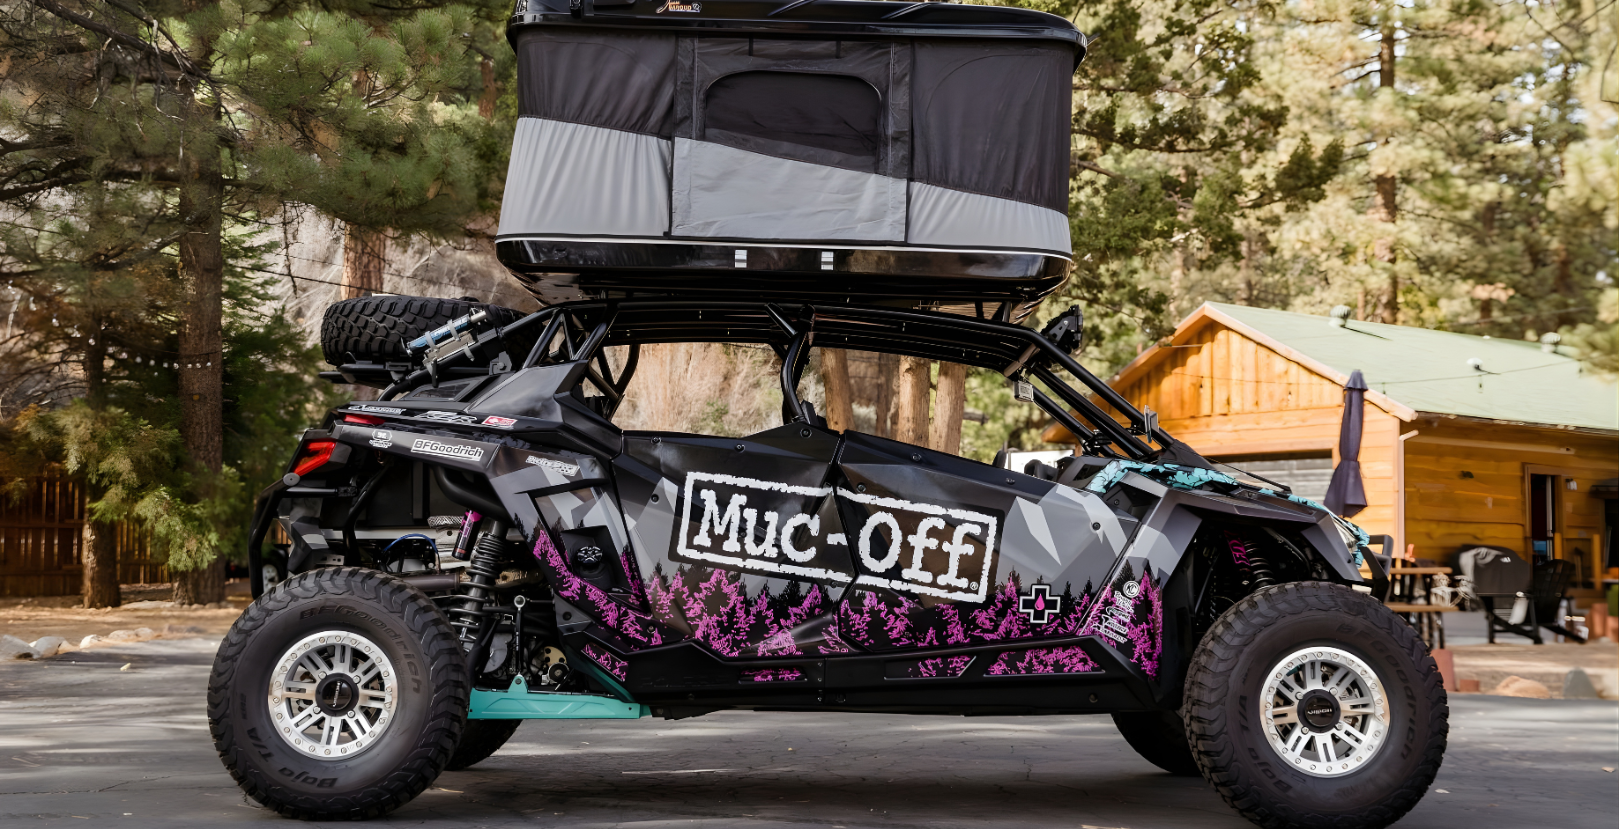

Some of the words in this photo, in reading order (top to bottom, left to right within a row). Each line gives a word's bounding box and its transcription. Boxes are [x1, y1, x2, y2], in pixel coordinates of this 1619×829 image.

[414, 440, 482, 457] BFGoodrich
[693, 489, 982, 589] Muc-Off
[300, 604, 422, 693] BFGoodrich
[278, 766, 338, 788] Baja
